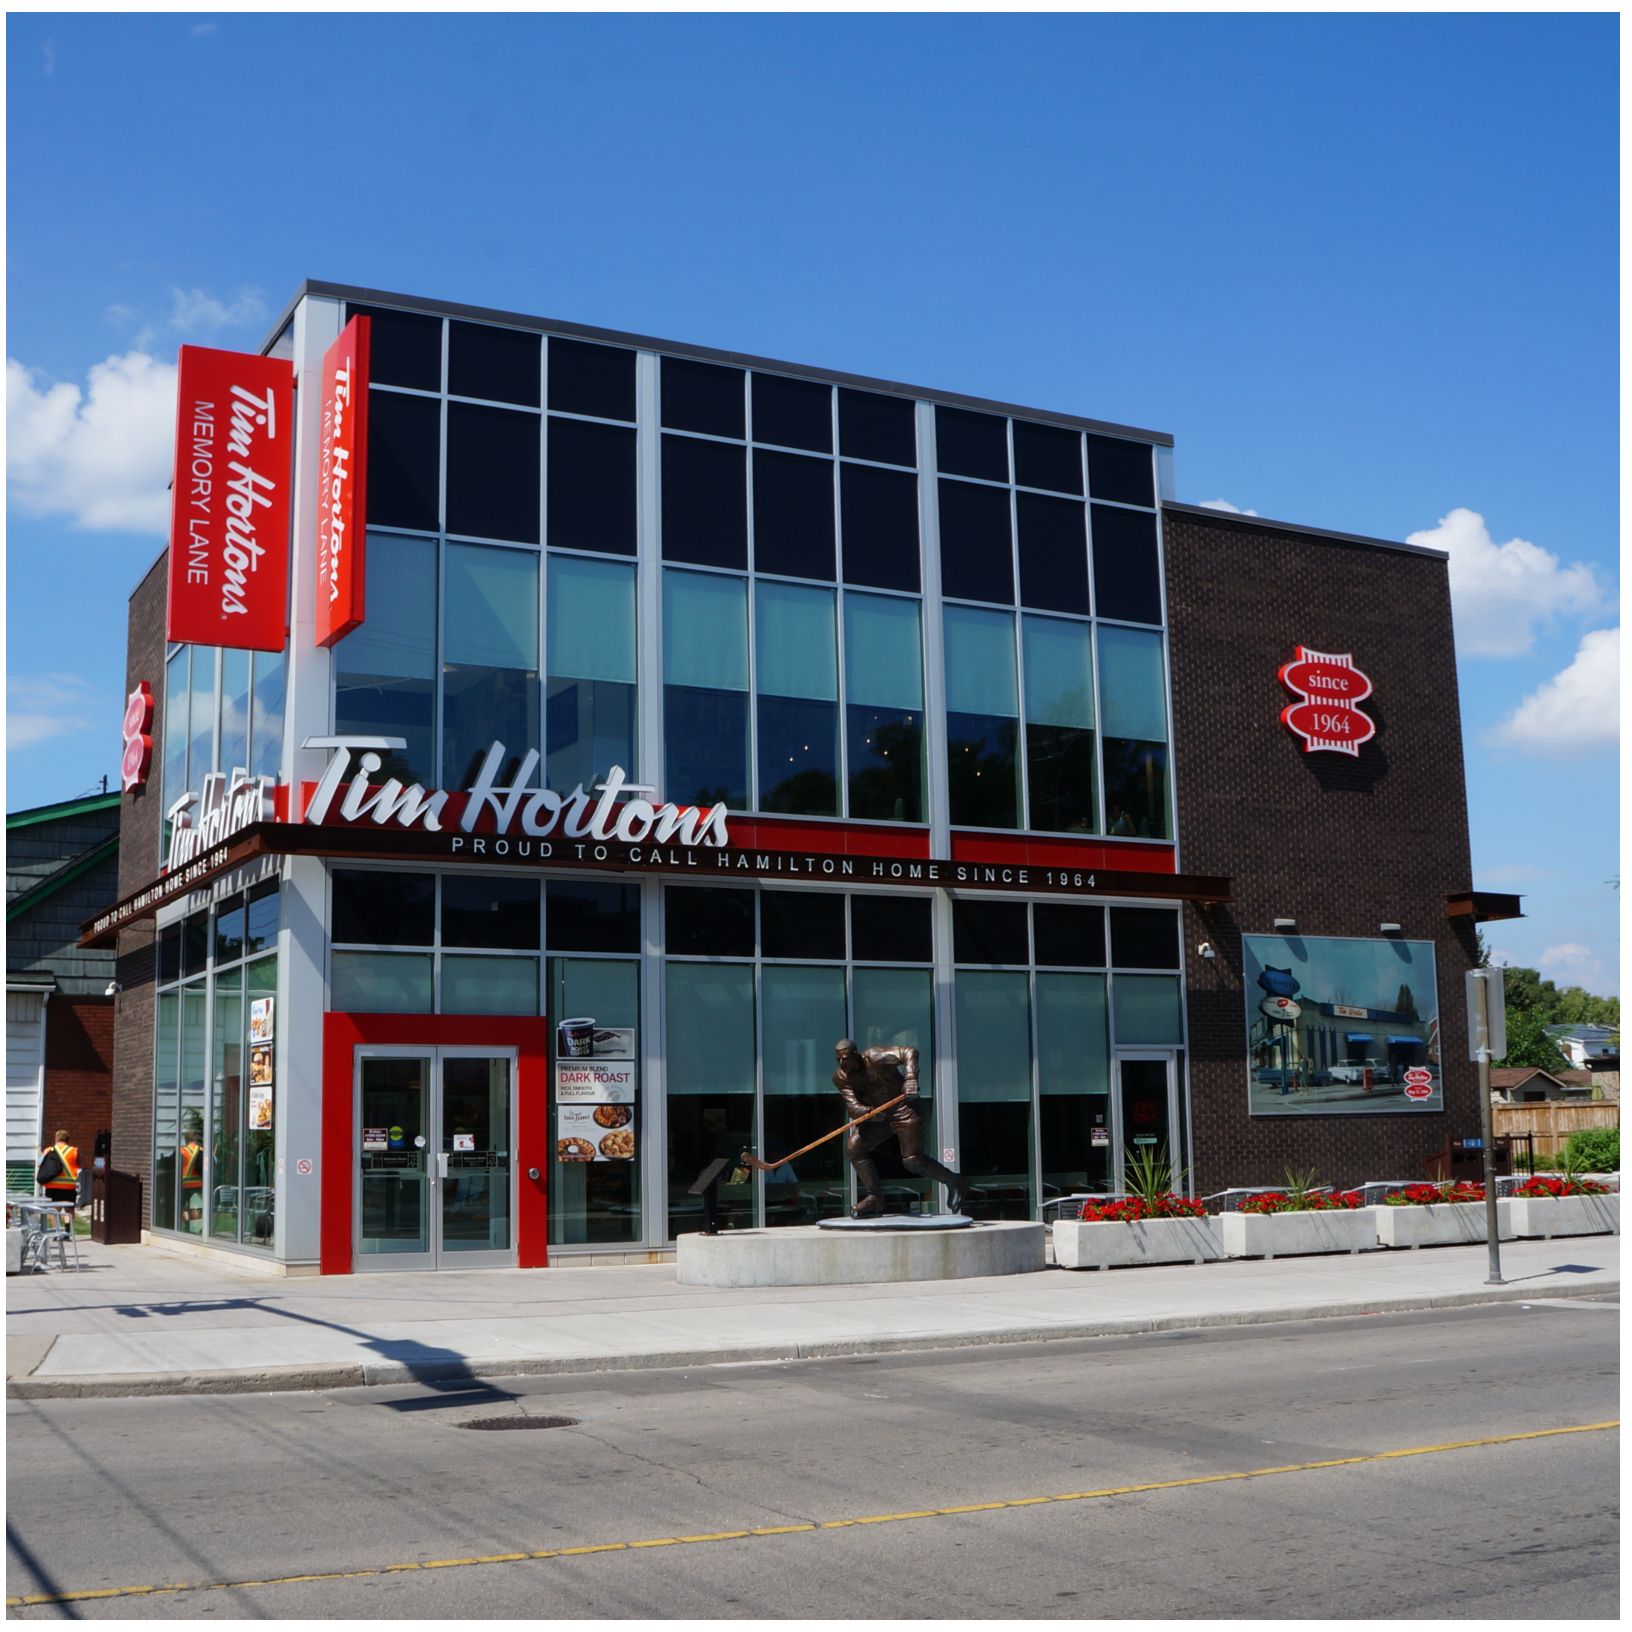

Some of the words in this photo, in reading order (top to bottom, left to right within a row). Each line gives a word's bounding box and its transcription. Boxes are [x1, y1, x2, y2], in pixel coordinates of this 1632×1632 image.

[228, 384, 276, 458] Tim
[334, 356, 351, 438] Tim
[191, 401, 215, 513] MEMORY
[321, 399, 332, 509] MEMORY
[187, 519, 210, 585] LANE
[222, 461, 276, 615] Hortons
[319, 518, 329, 586] LANE
[330, 446, 350, 602] Hortons
[1308, 669, 1349, 691] since
[1312, 713, 1350, 734] 1964
[301, 735, 449, 832] Tim
[461, 740, 729, 848] Hortons
[168, 792, 200, 874] Tim
[451, 836, 553, 858] PROUD
[574, 844, 608, 861] TO
[629, 847, 697, 866] CALL
[717, 852, 854, 875] HAMILTON
[872, 861, 940, 880] HOME
[956, 867, 1029, 884] SINCE
[1046, 872, 1097, 888] 1964
[93, 915, 110, 934] PROUD
[111, 910, 118, 924] TO
[119, 902, 132, 920] CALL
[134, 884, 163, 911] HAMILTON
[165, 874, 183, 893] HOME
[185, 860, 208, 883] SINCE
[210, 846, 228, 869] 1964
[560, 1072, 591, 1083] DARK
[593, 1072, 631, 1083] ROAST
[567, 1036, 591, 1047] DARK
